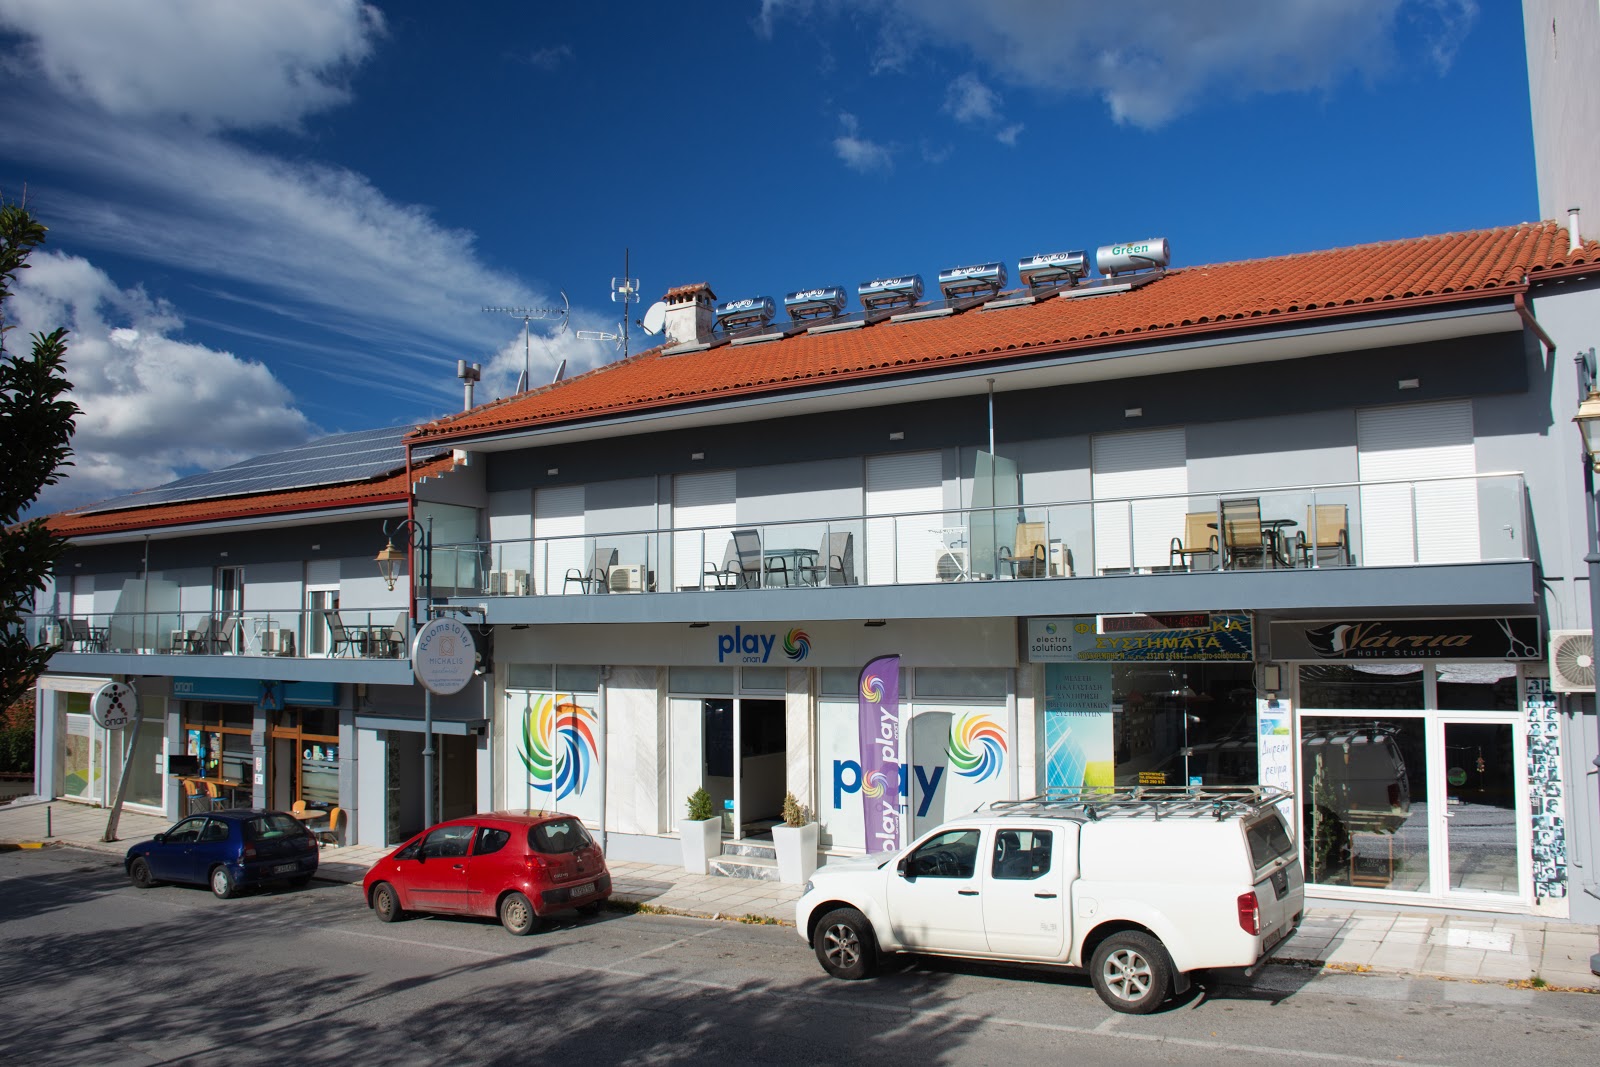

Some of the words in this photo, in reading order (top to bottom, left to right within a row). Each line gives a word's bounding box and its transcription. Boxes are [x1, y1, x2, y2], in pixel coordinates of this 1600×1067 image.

[1112, 244, 1149, 256] Green
[420, 623, 450, 651] Rooms
[452, 623, 461, 635] to
[459, 630, 472, 648] let
[718, 625, 776, 663] play
[1095, 636, 1221, 650] ΣΥΣΤΗΜΑΤΑ
[1031, 644, 1072, 652] solutions
[1357, 649, 1386, 657] Hair
[1394, 649, 1441, 657] Studio
[875, 706, 899, 764] play
